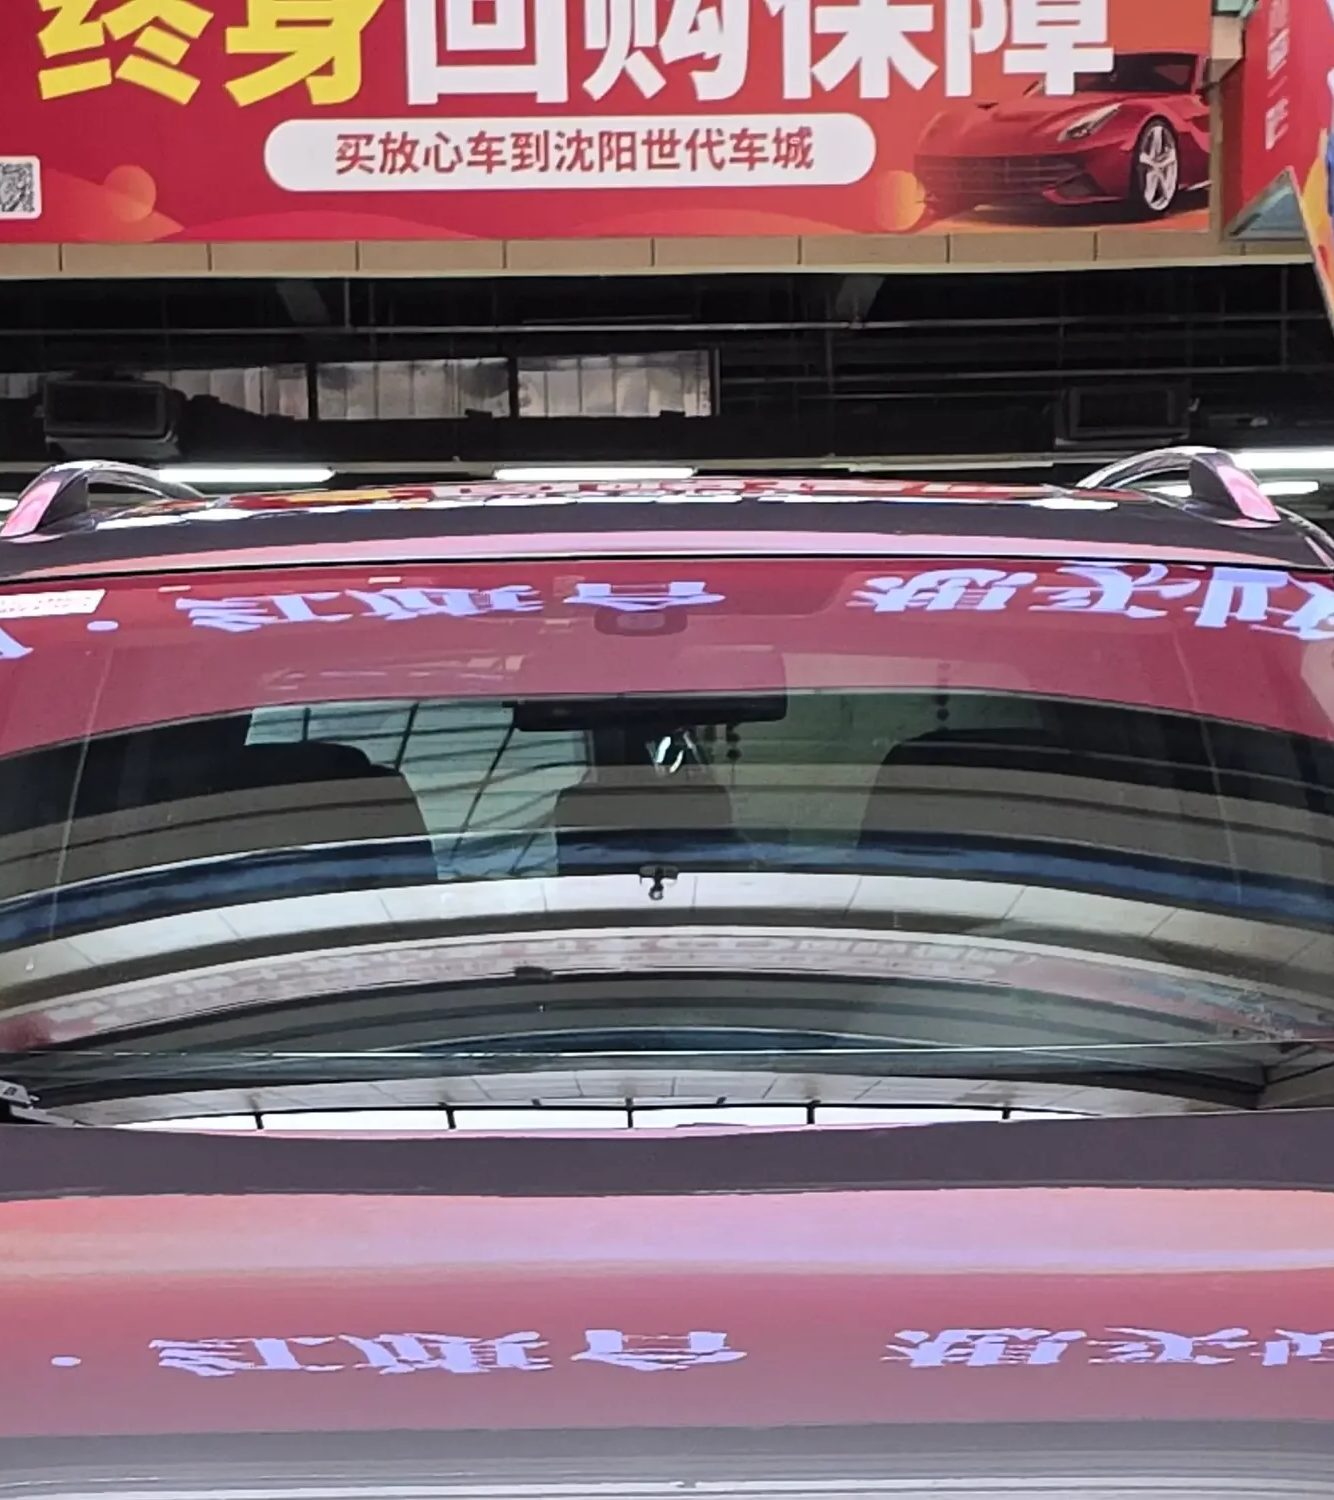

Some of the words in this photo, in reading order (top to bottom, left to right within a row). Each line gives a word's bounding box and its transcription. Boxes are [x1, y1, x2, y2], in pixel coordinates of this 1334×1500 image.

[36, 0, 1115, 107] 终身回购保障
[334, 124, 814, 175] 买放心车到沈阳世代车城
